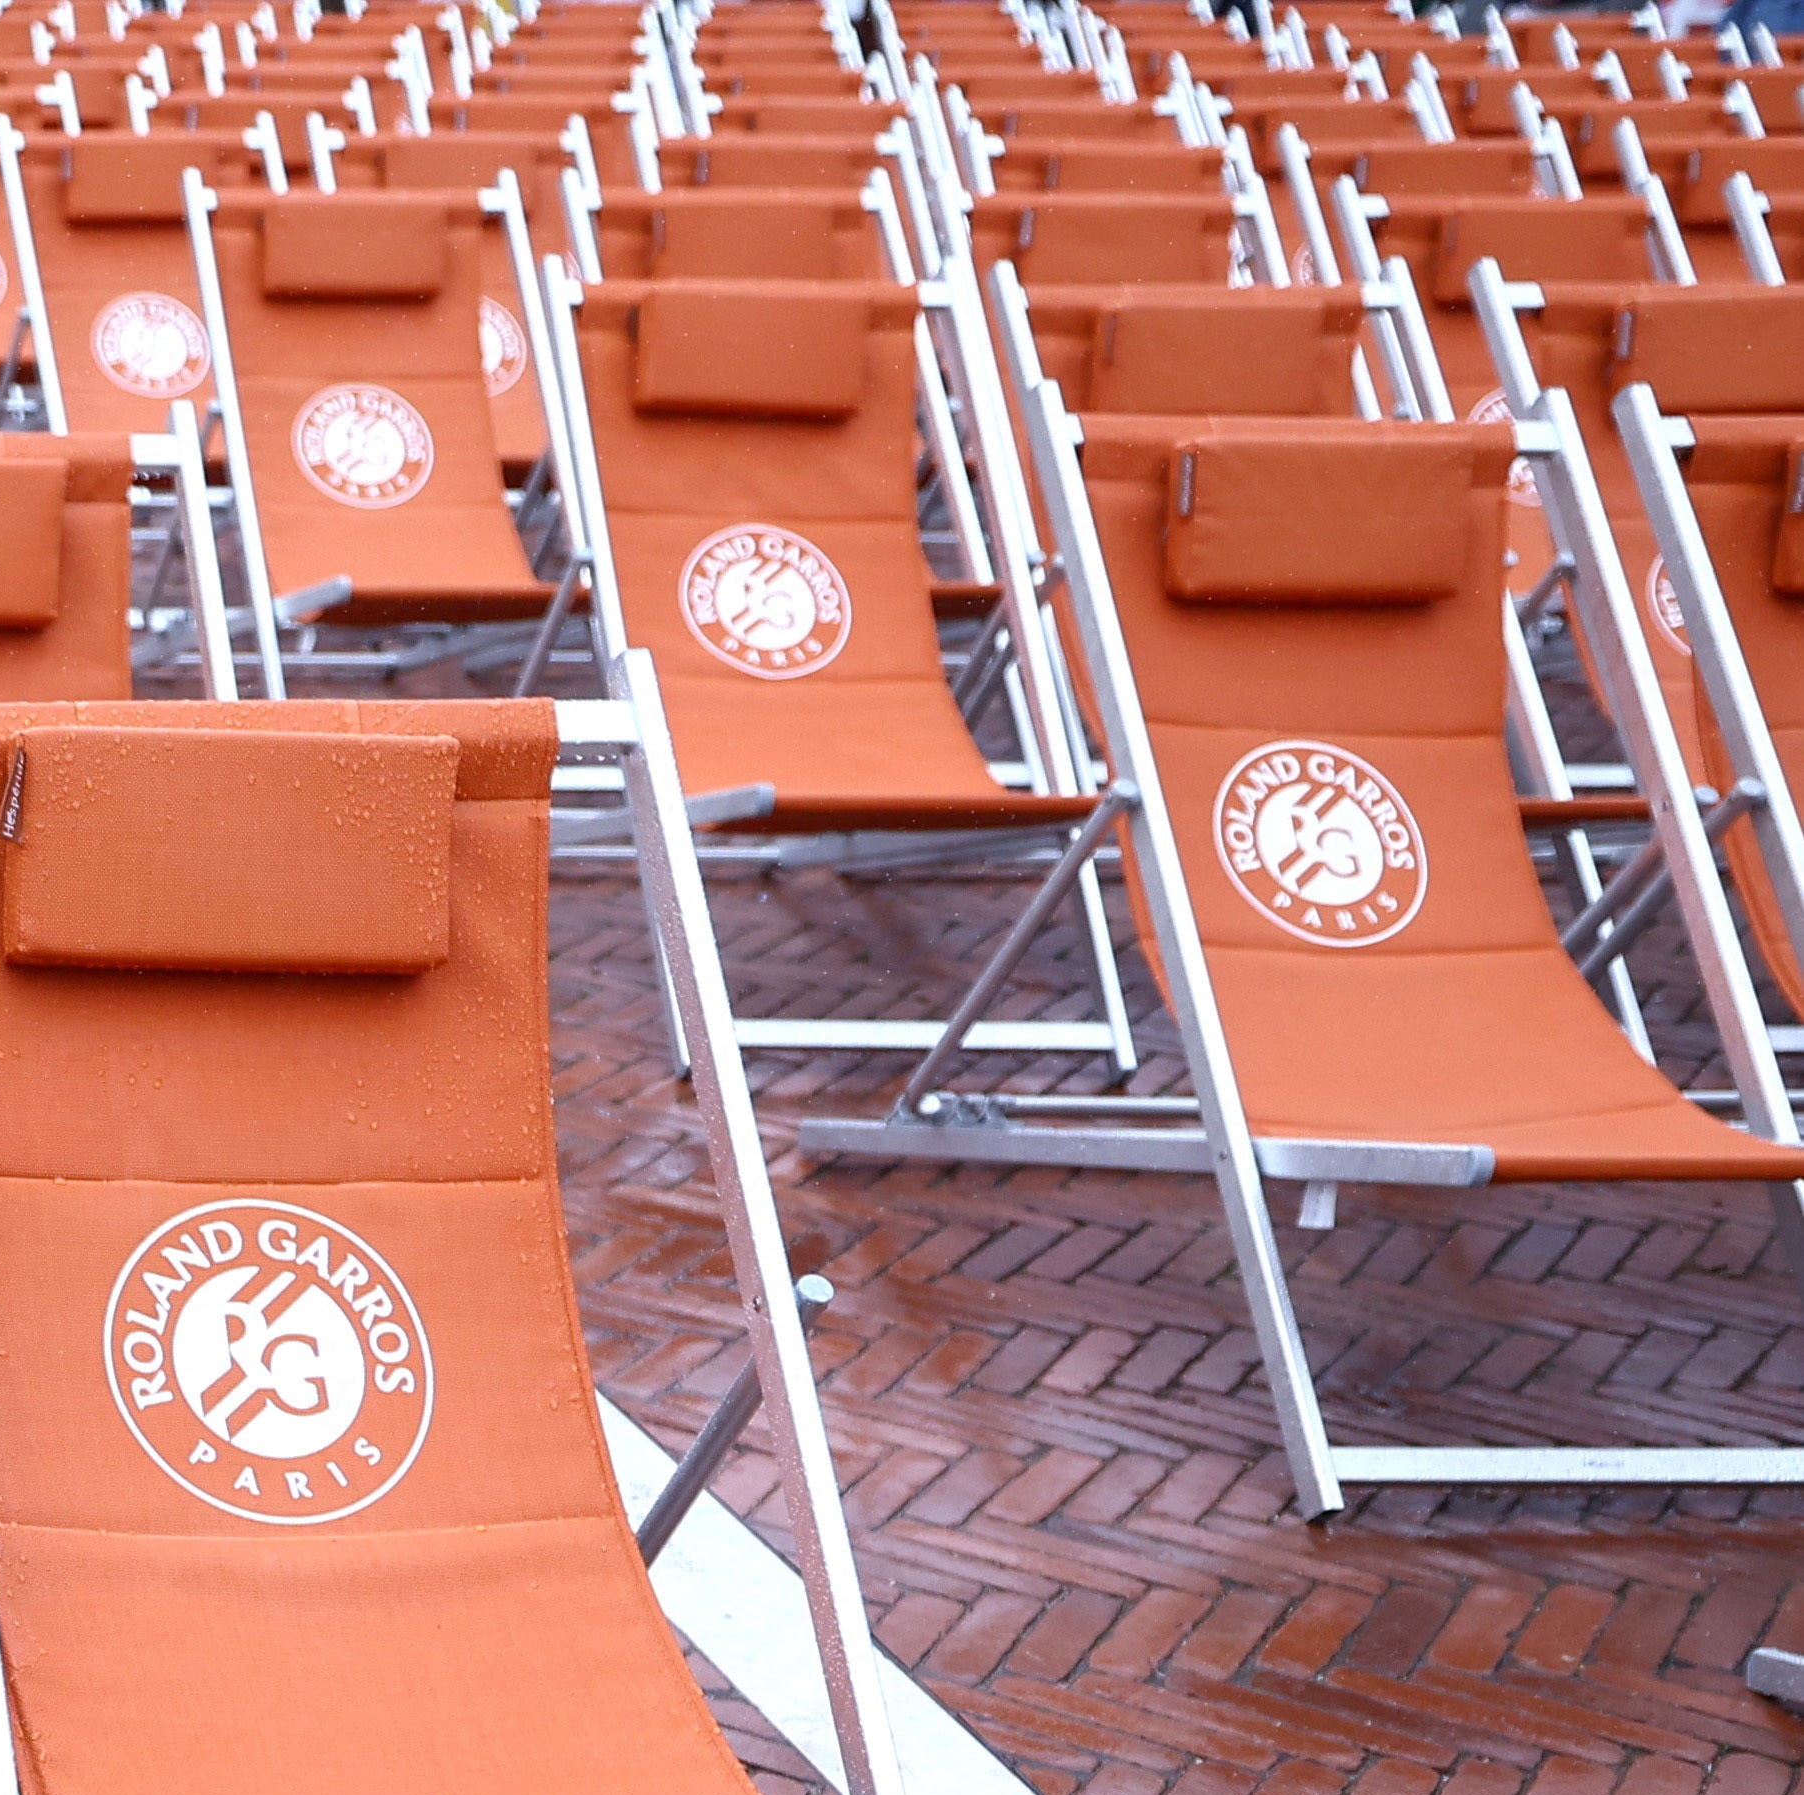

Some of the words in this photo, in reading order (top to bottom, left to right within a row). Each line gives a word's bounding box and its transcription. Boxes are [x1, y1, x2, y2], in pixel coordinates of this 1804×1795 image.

[689, 535, 756, 625] ROLAND
[759, 535, 841, 624] GARROS
[1224, 752, 1301, 872] ROLAND
[1306, 753, 1414, 870] GARROS
[1273, 891, 1399, 931] PARIS
[123, 1219, 244, 1410] ROLAND
[257, 1218, 416, 1394] GARROS
[188, 1436, 383, 1500] PARIS
